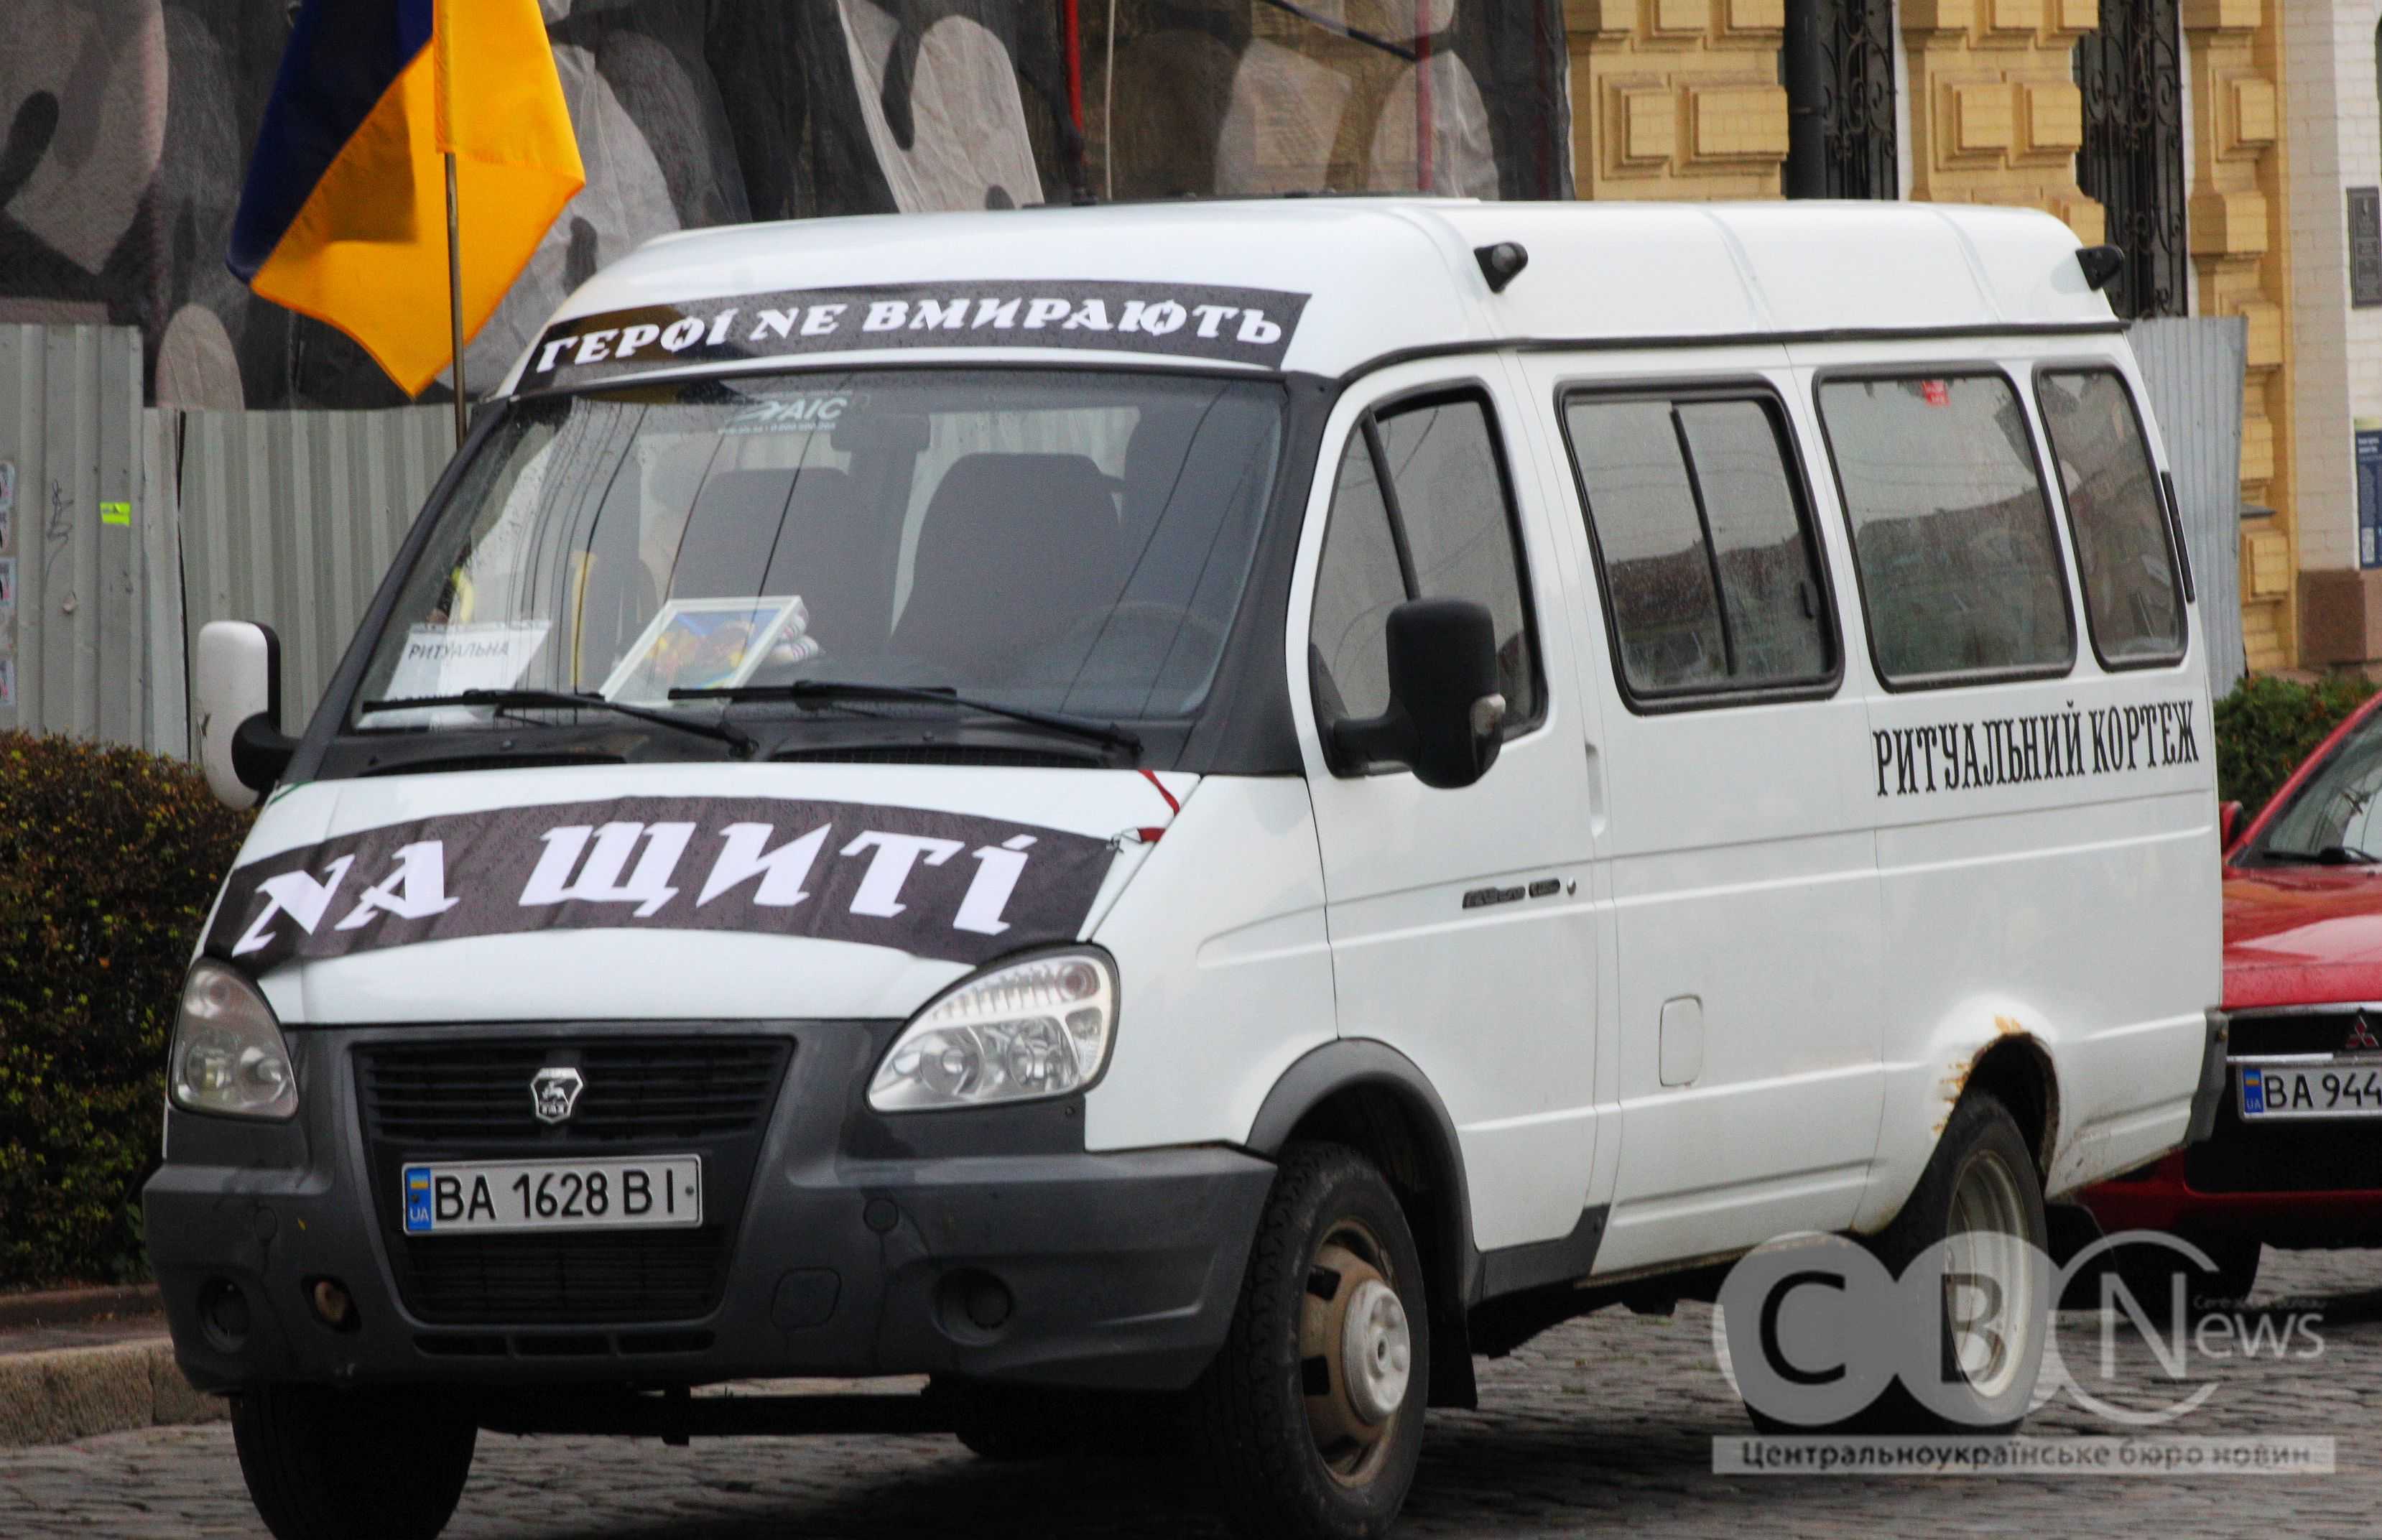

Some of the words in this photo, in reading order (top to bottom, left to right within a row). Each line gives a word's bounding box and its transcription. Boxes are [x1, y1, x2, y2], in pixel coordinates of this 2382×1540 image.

[861, 297, 1283, 345] ВМИРАЮТЬ
[1872, 700, 2085, 797] РИТУАЛЬНИЙ
[2088, 700, 2199, 775] КОРТЕЖ
[519, 819, 1030, 936] ЩИТІ
[2264, 1074, 2314, 1108] BA
[410, 1207, 429, 1221] UA
[435, 1175, 496, 1220] BA
[512, 1170, 608, 1218] 1628
[623, 1169, 675, 1215] BI
